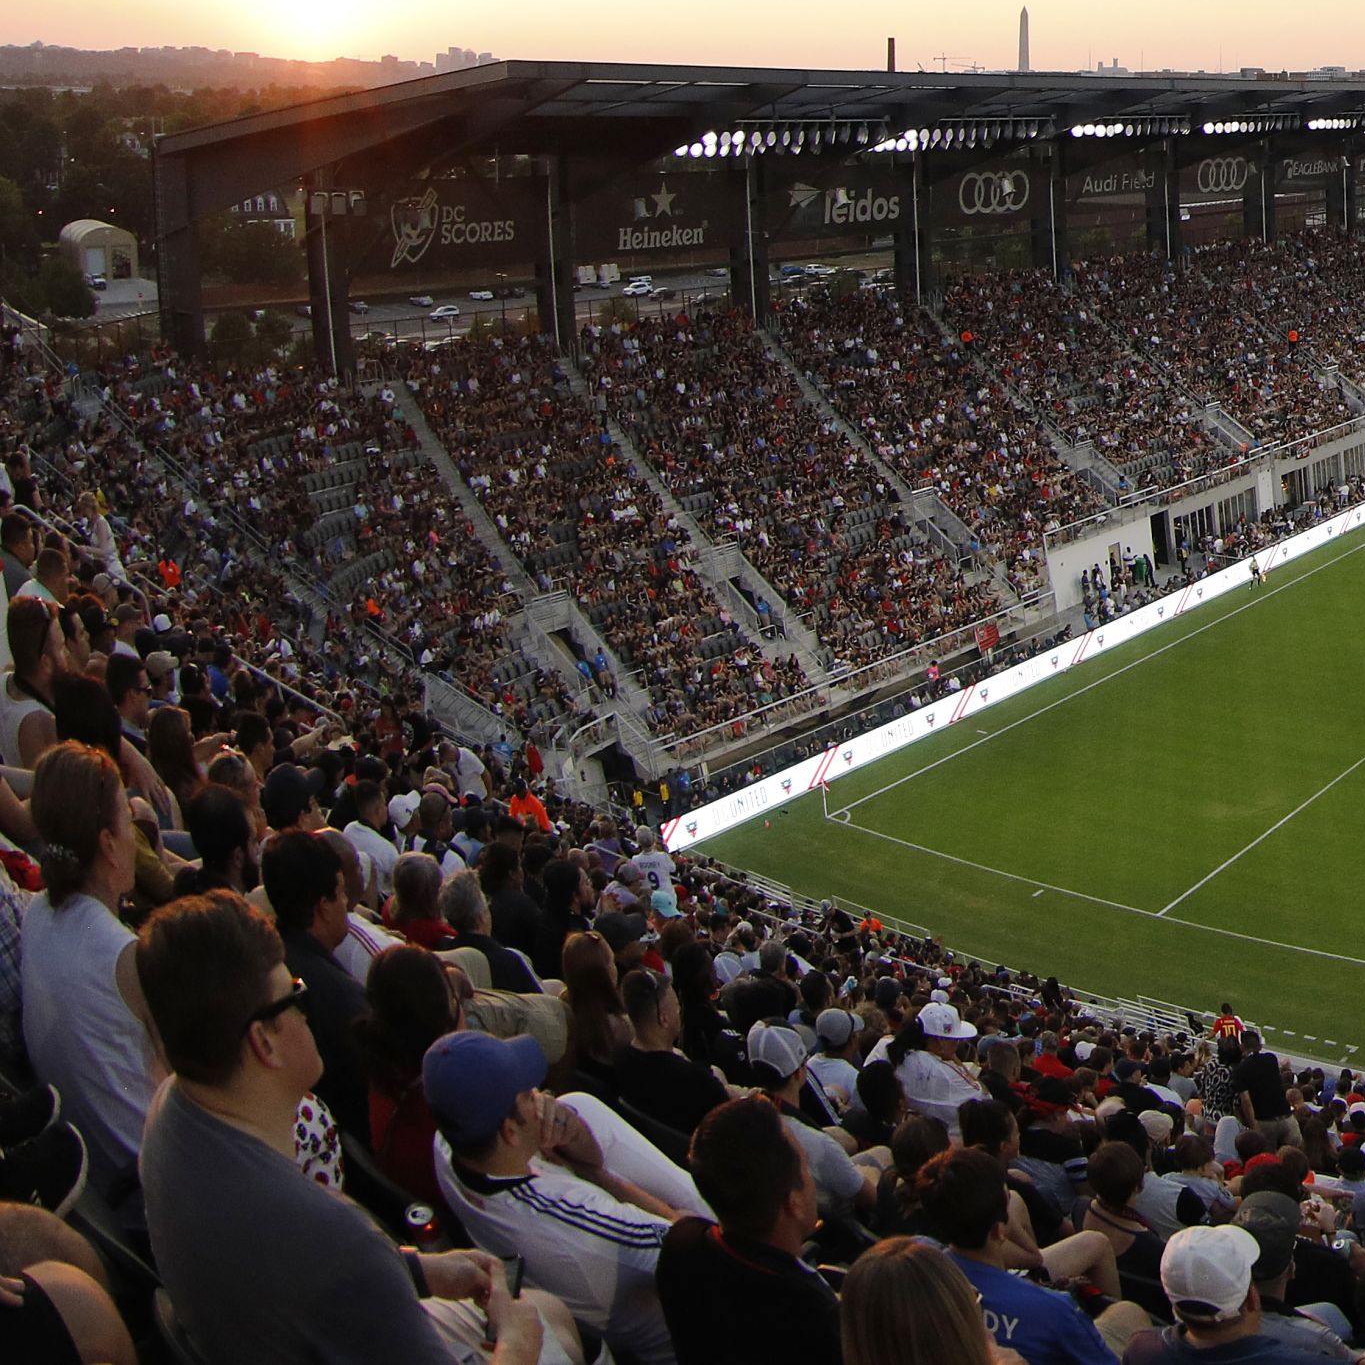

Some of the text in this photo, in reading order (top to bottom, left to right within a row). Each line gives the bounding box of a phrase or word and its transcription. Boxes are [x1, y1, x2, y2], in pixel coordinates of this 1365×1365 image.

[1082, 176, 1118, 194] Audi
[441, 205, 466, 224] DC
[824, 189, 900, 224] leidos
[441, 221, 515, 244] SCORES
[618, 226, 704, 250] Heineken
[648, 871, 660, 890] 9
